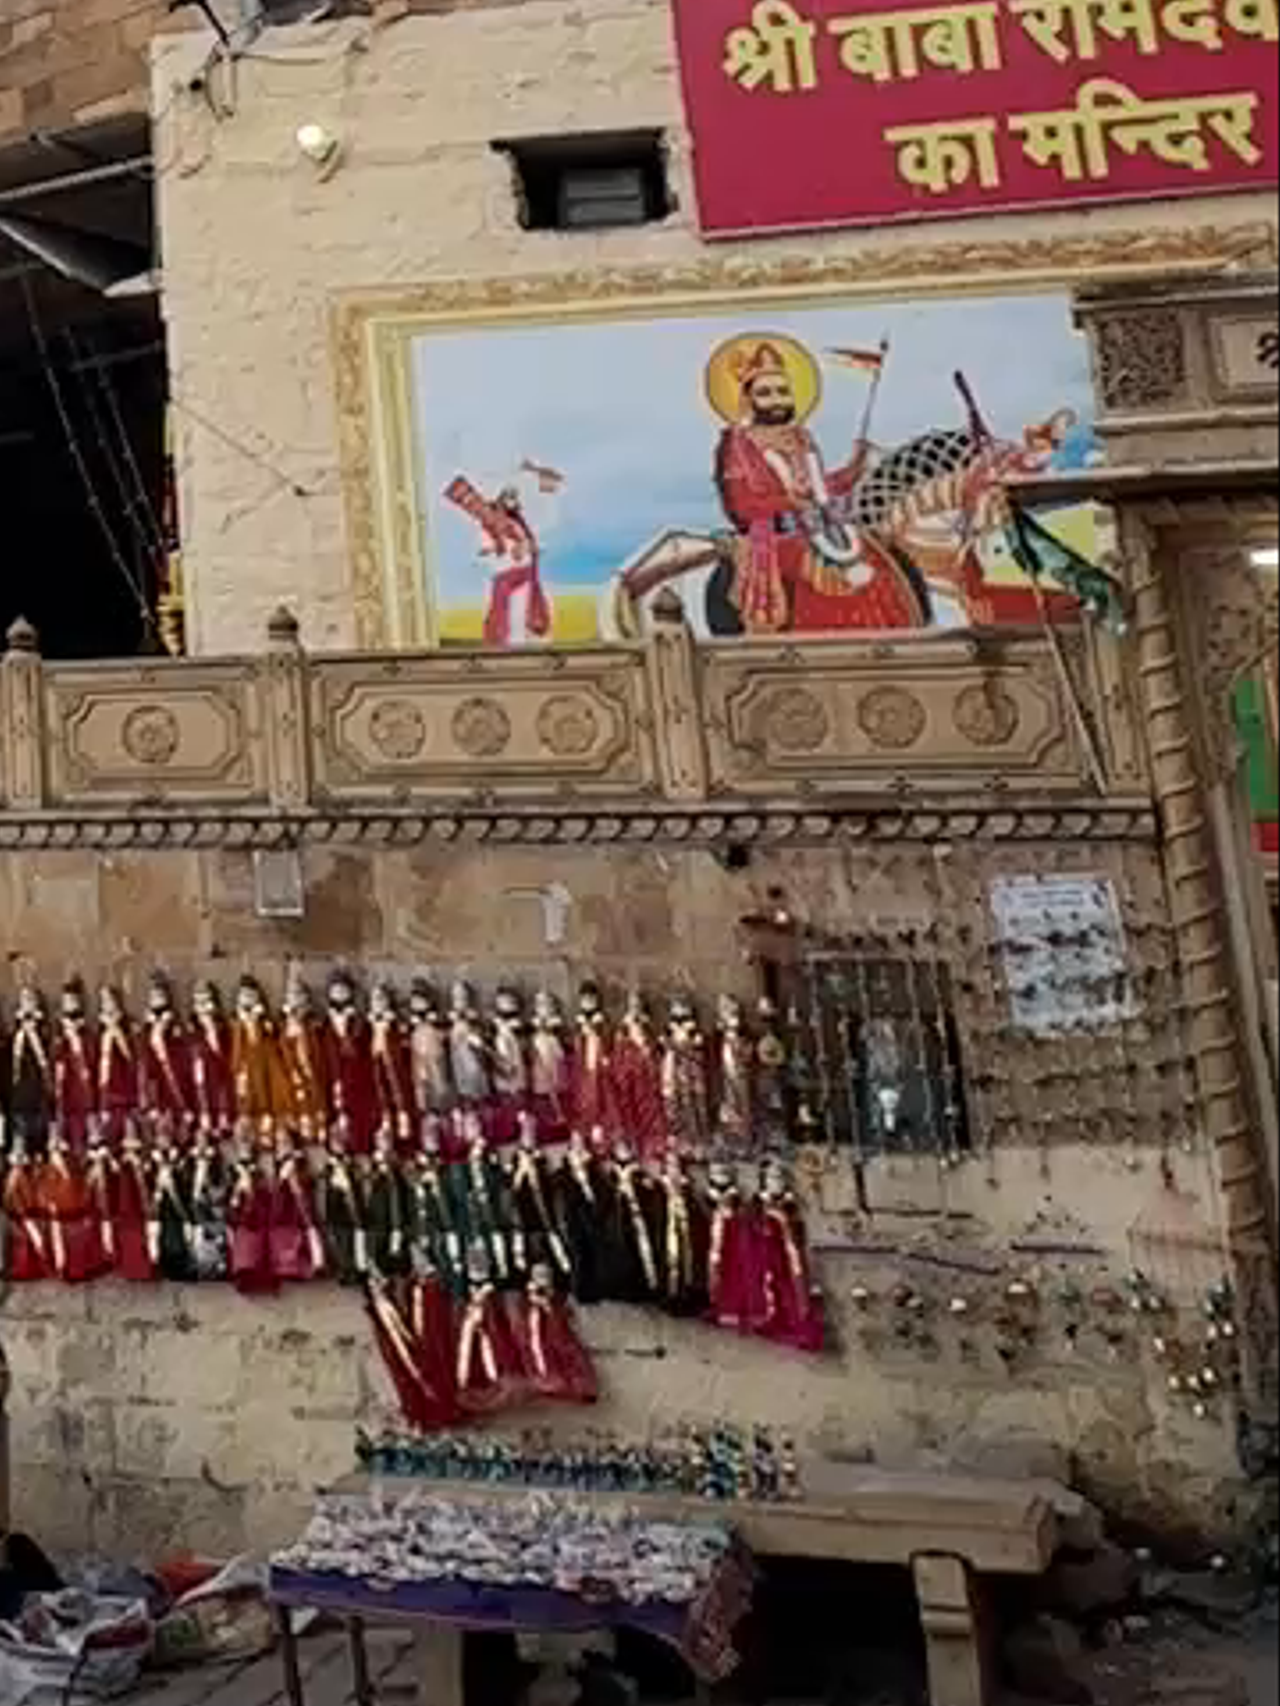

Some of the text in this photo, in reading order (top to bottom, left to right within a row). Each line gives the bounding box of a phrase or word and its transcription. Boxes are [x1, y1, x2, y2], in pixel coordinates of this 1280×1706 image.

[827, 2, 1002, 82] बाबा
[883, 79, 1264, 192] का मन्दिर
